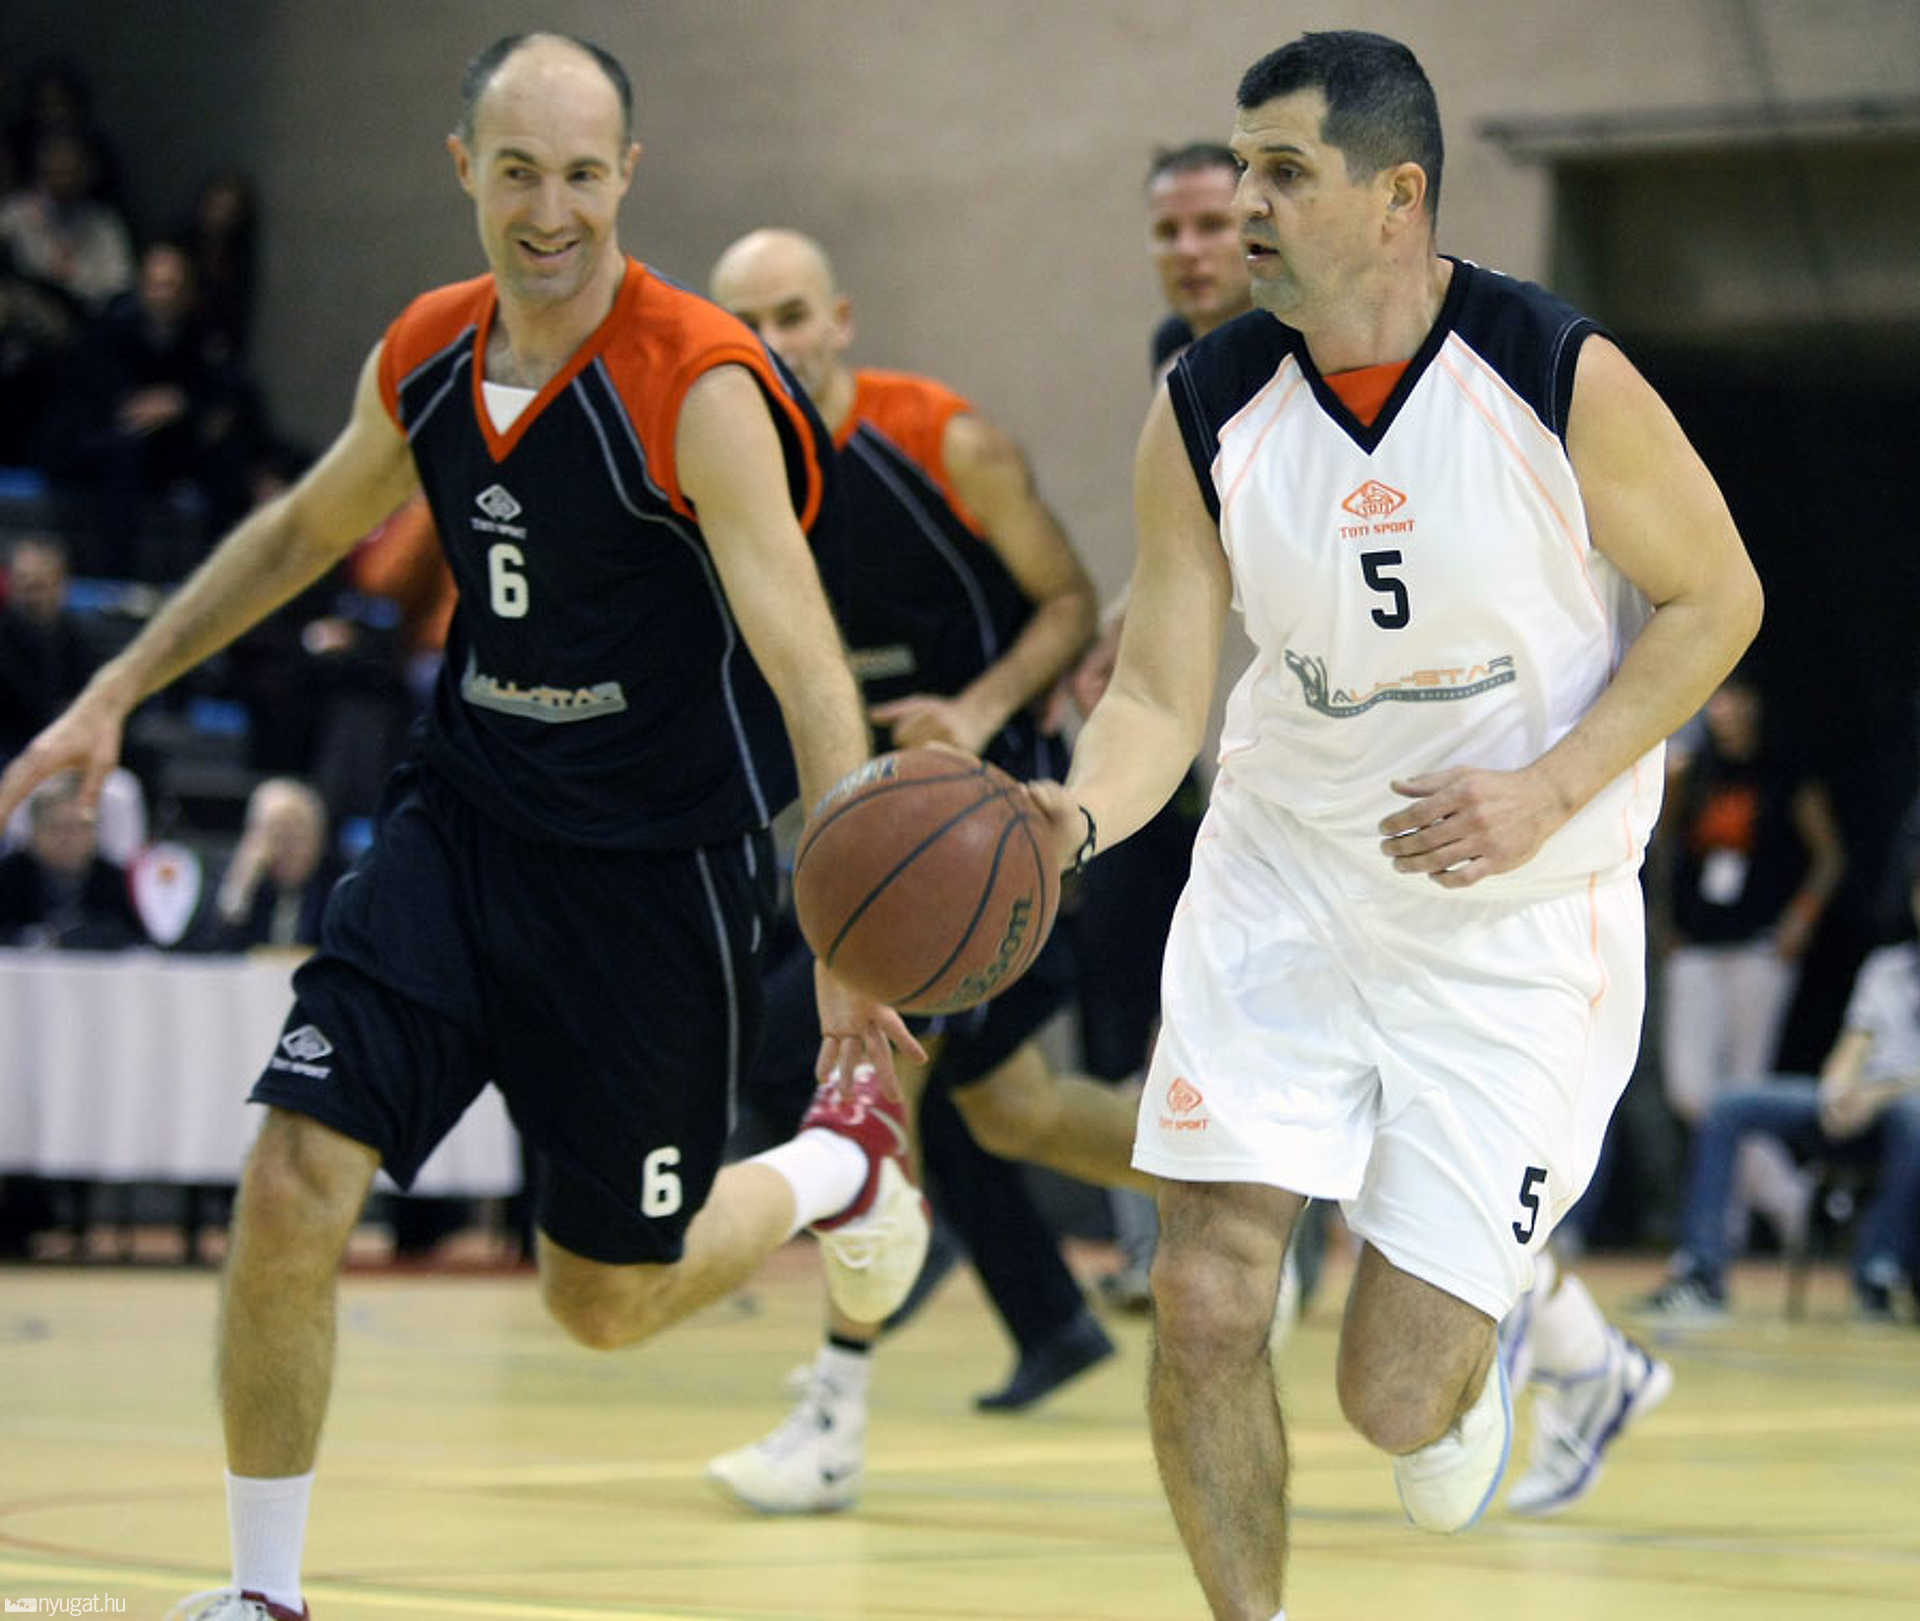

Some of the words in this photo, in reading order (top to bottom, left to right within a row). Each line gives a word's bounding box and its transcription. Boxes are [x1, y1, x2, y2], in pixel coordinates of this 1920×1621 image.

[1374, 519, 1415, 534] SPORT
[488, 543, 529, 618] 6
[1360, 550, 1410, 629] 5
[641, 1146, 683, 1218] 6
[1512, 1166, 1547, 1245] 5
